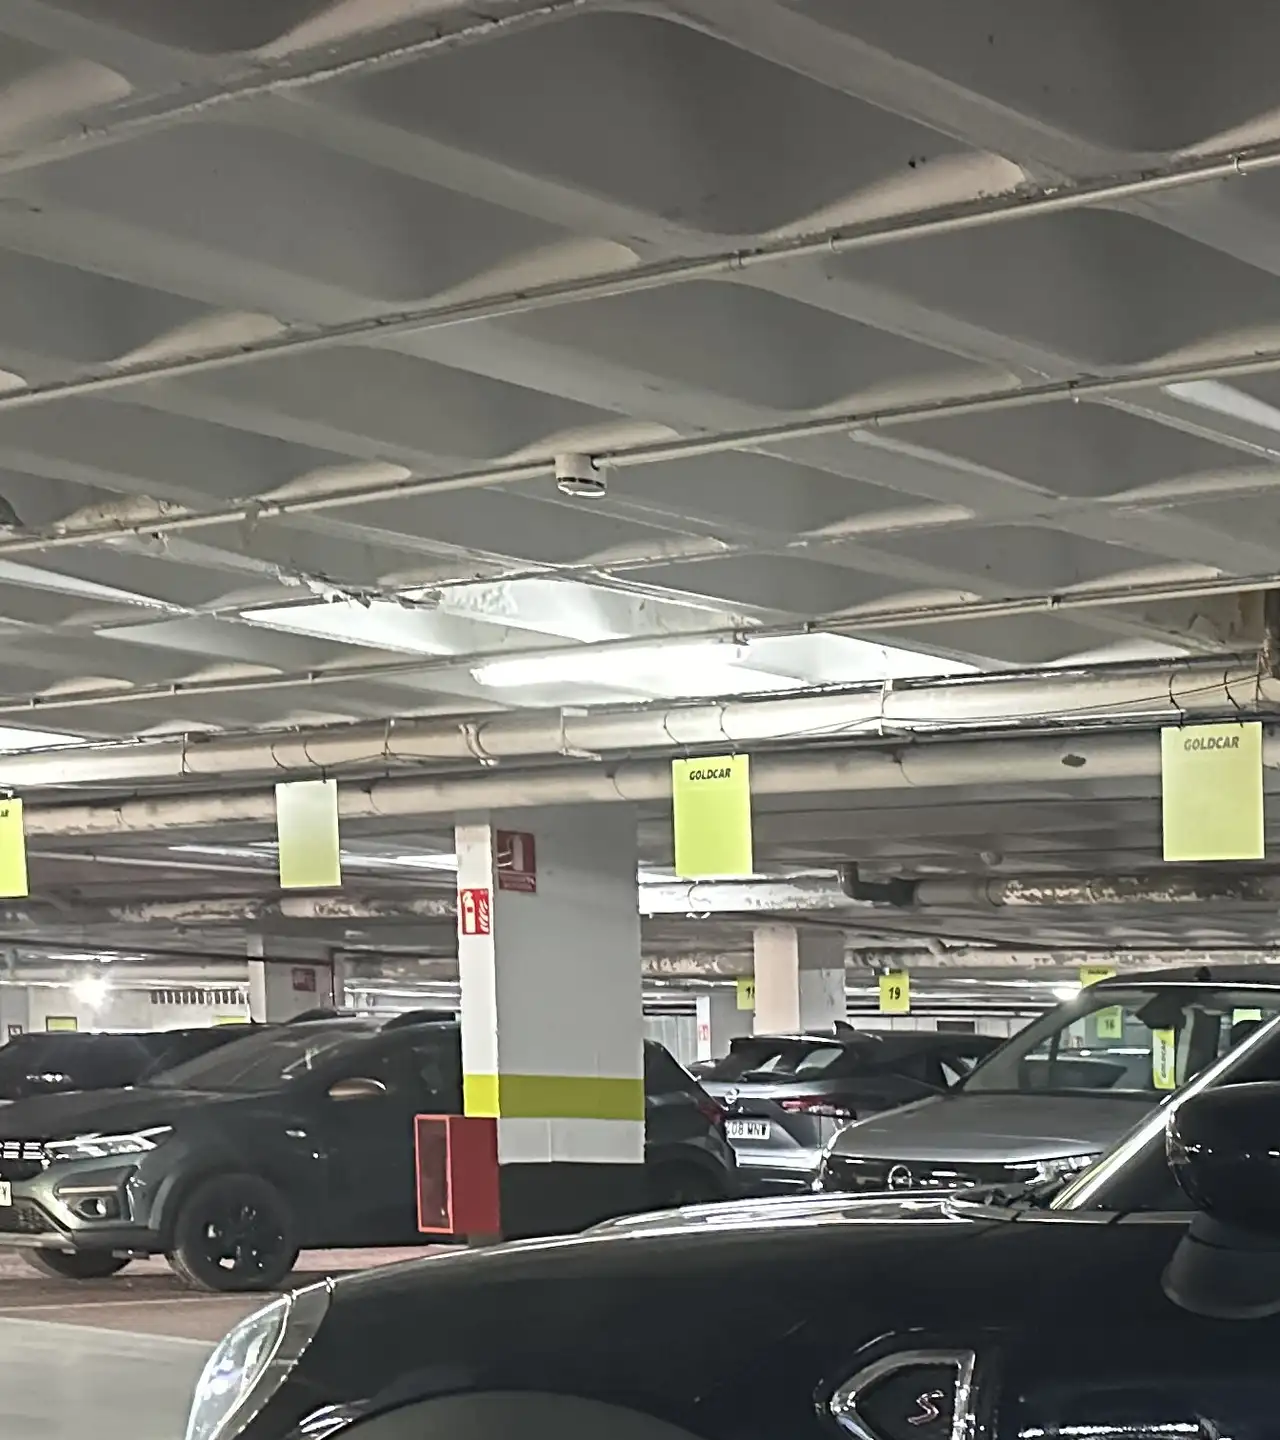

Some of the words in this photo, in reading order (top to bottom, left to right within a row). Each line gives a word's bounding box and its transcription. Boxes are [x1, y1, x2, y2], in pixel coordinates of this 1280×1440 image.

[1183, 735, 1240, 751] GOLDCAR
[689, 767, 731, 781] GOLDCAR
[889, 986, 901, 1000] 19
[908, 1390, 944, 1426] S
